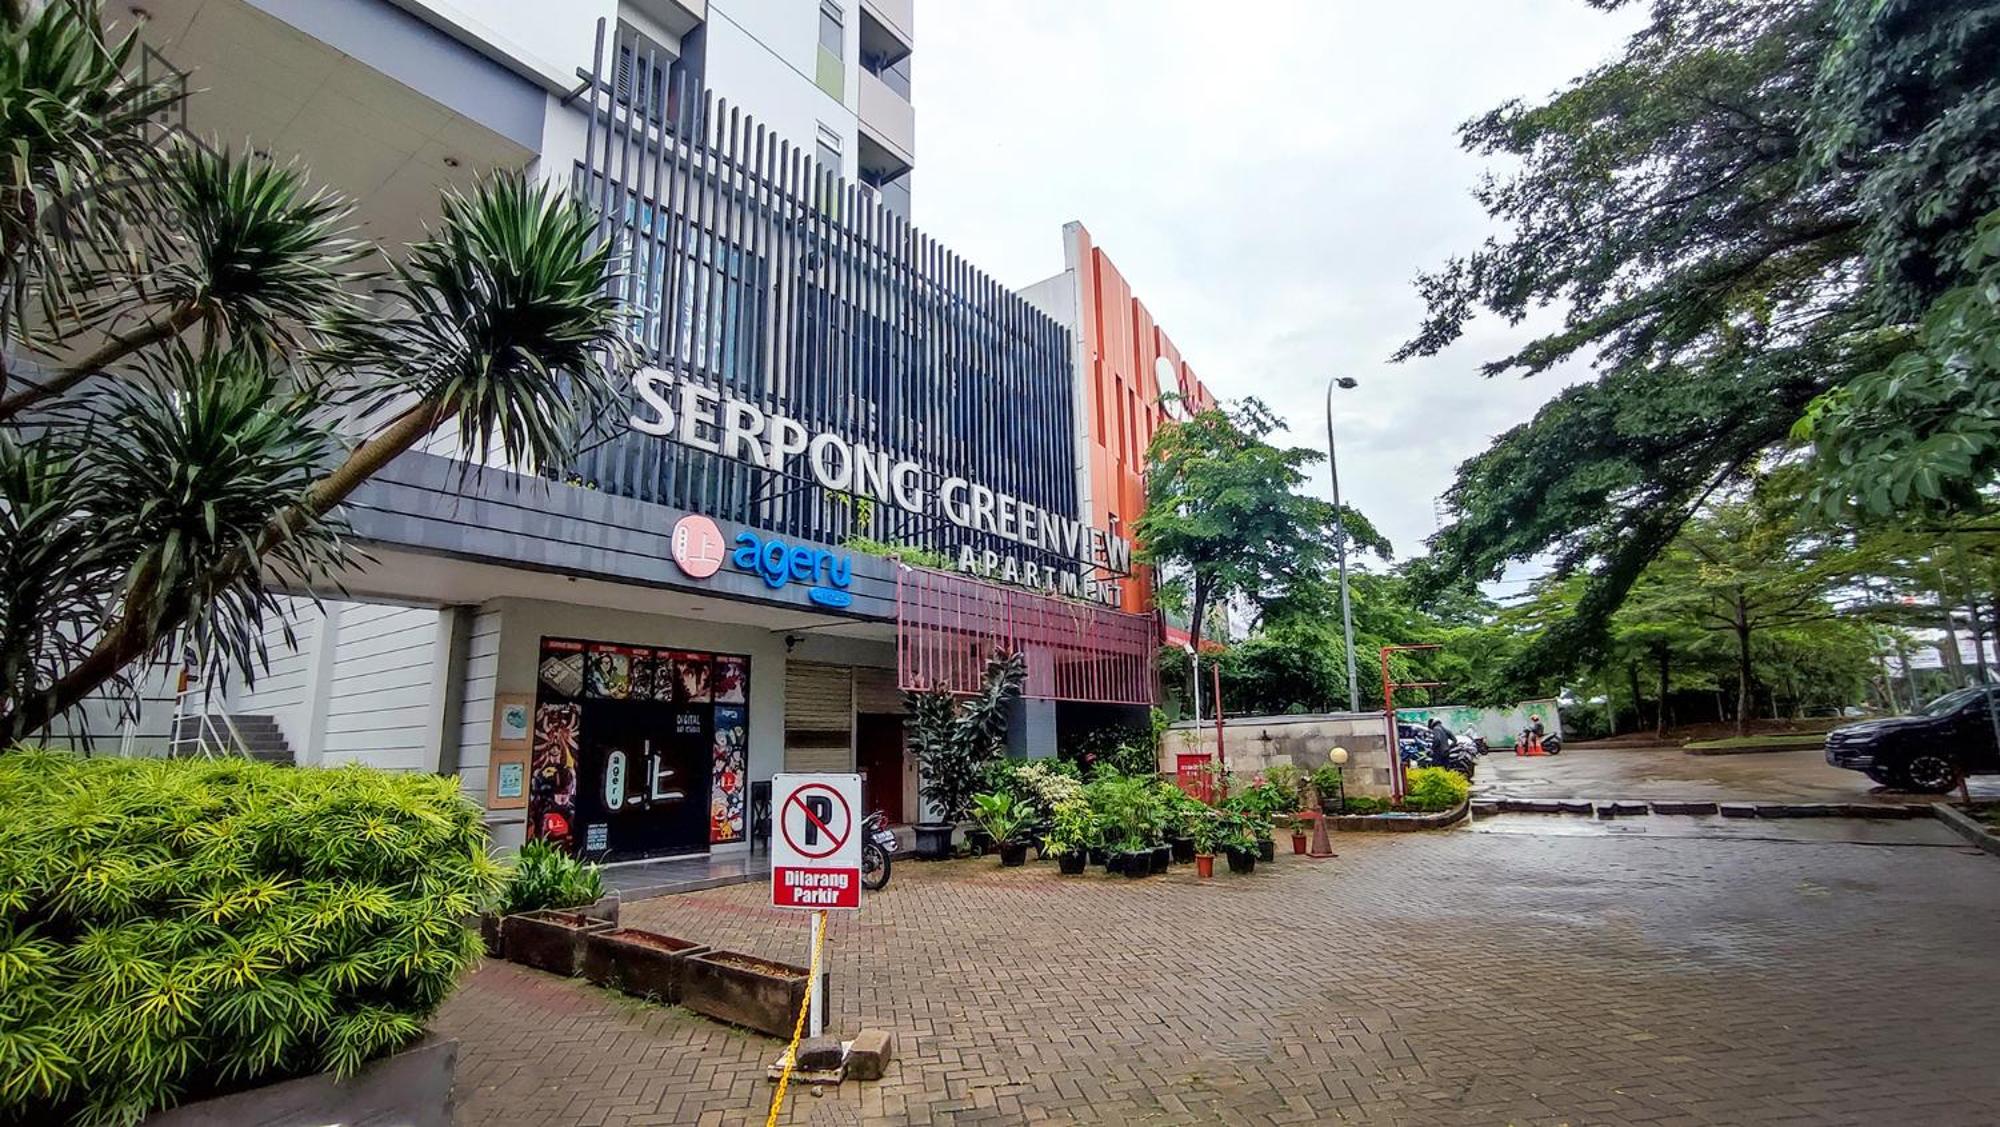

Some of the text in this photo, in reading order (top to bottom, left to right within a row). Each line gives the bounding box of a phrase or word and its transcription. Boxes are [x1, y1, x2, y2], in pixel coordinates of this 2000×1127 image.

[630, 366, 1131, 574] SERPONG GREENVIEW
[732, 530, 851, 588] ageru
[957, 544, 1123, 608] APARTMENT
[805, 795, 832, 845] P
[784, 870, 849, 889] Dilarang
[793, 888, 840, 904] Parkir
